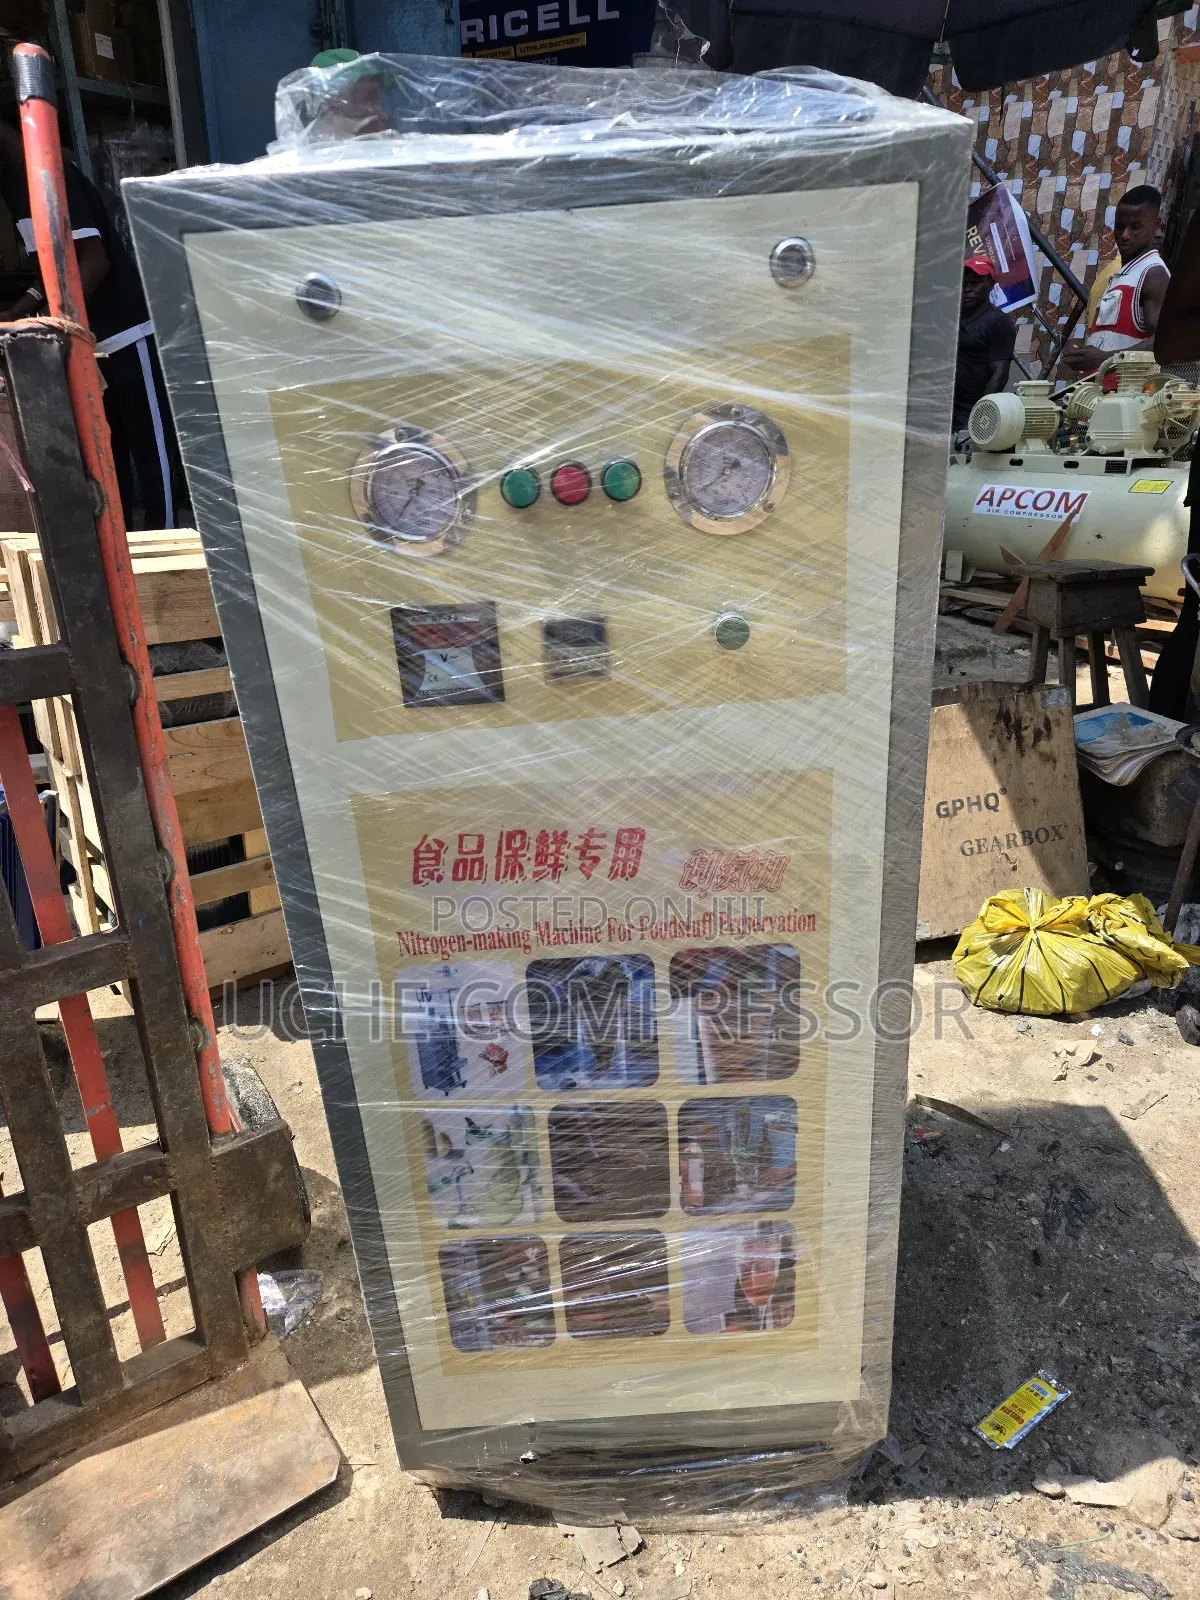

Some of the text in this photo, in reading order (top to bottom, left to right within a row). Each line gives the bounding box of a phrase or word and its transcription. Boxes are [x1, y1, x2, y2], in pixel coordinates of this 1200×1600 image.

[520, 36, 580, 53] LITHIUM BATTERY
[976, 486, 1088, 514] APCOM
[1004, 509, 1063, 520] COMPRESSOR
[960, 824, 1066, 857] GEARBOX
[412, 826, 646, 886] 食品保鲜专用
[396, 924, 532, 960] Nitrogen-making
[536, 919, 602, 947] Machine
[607, 917, 634, 942] For
[639, 911, 714, 941] Foodstuff
